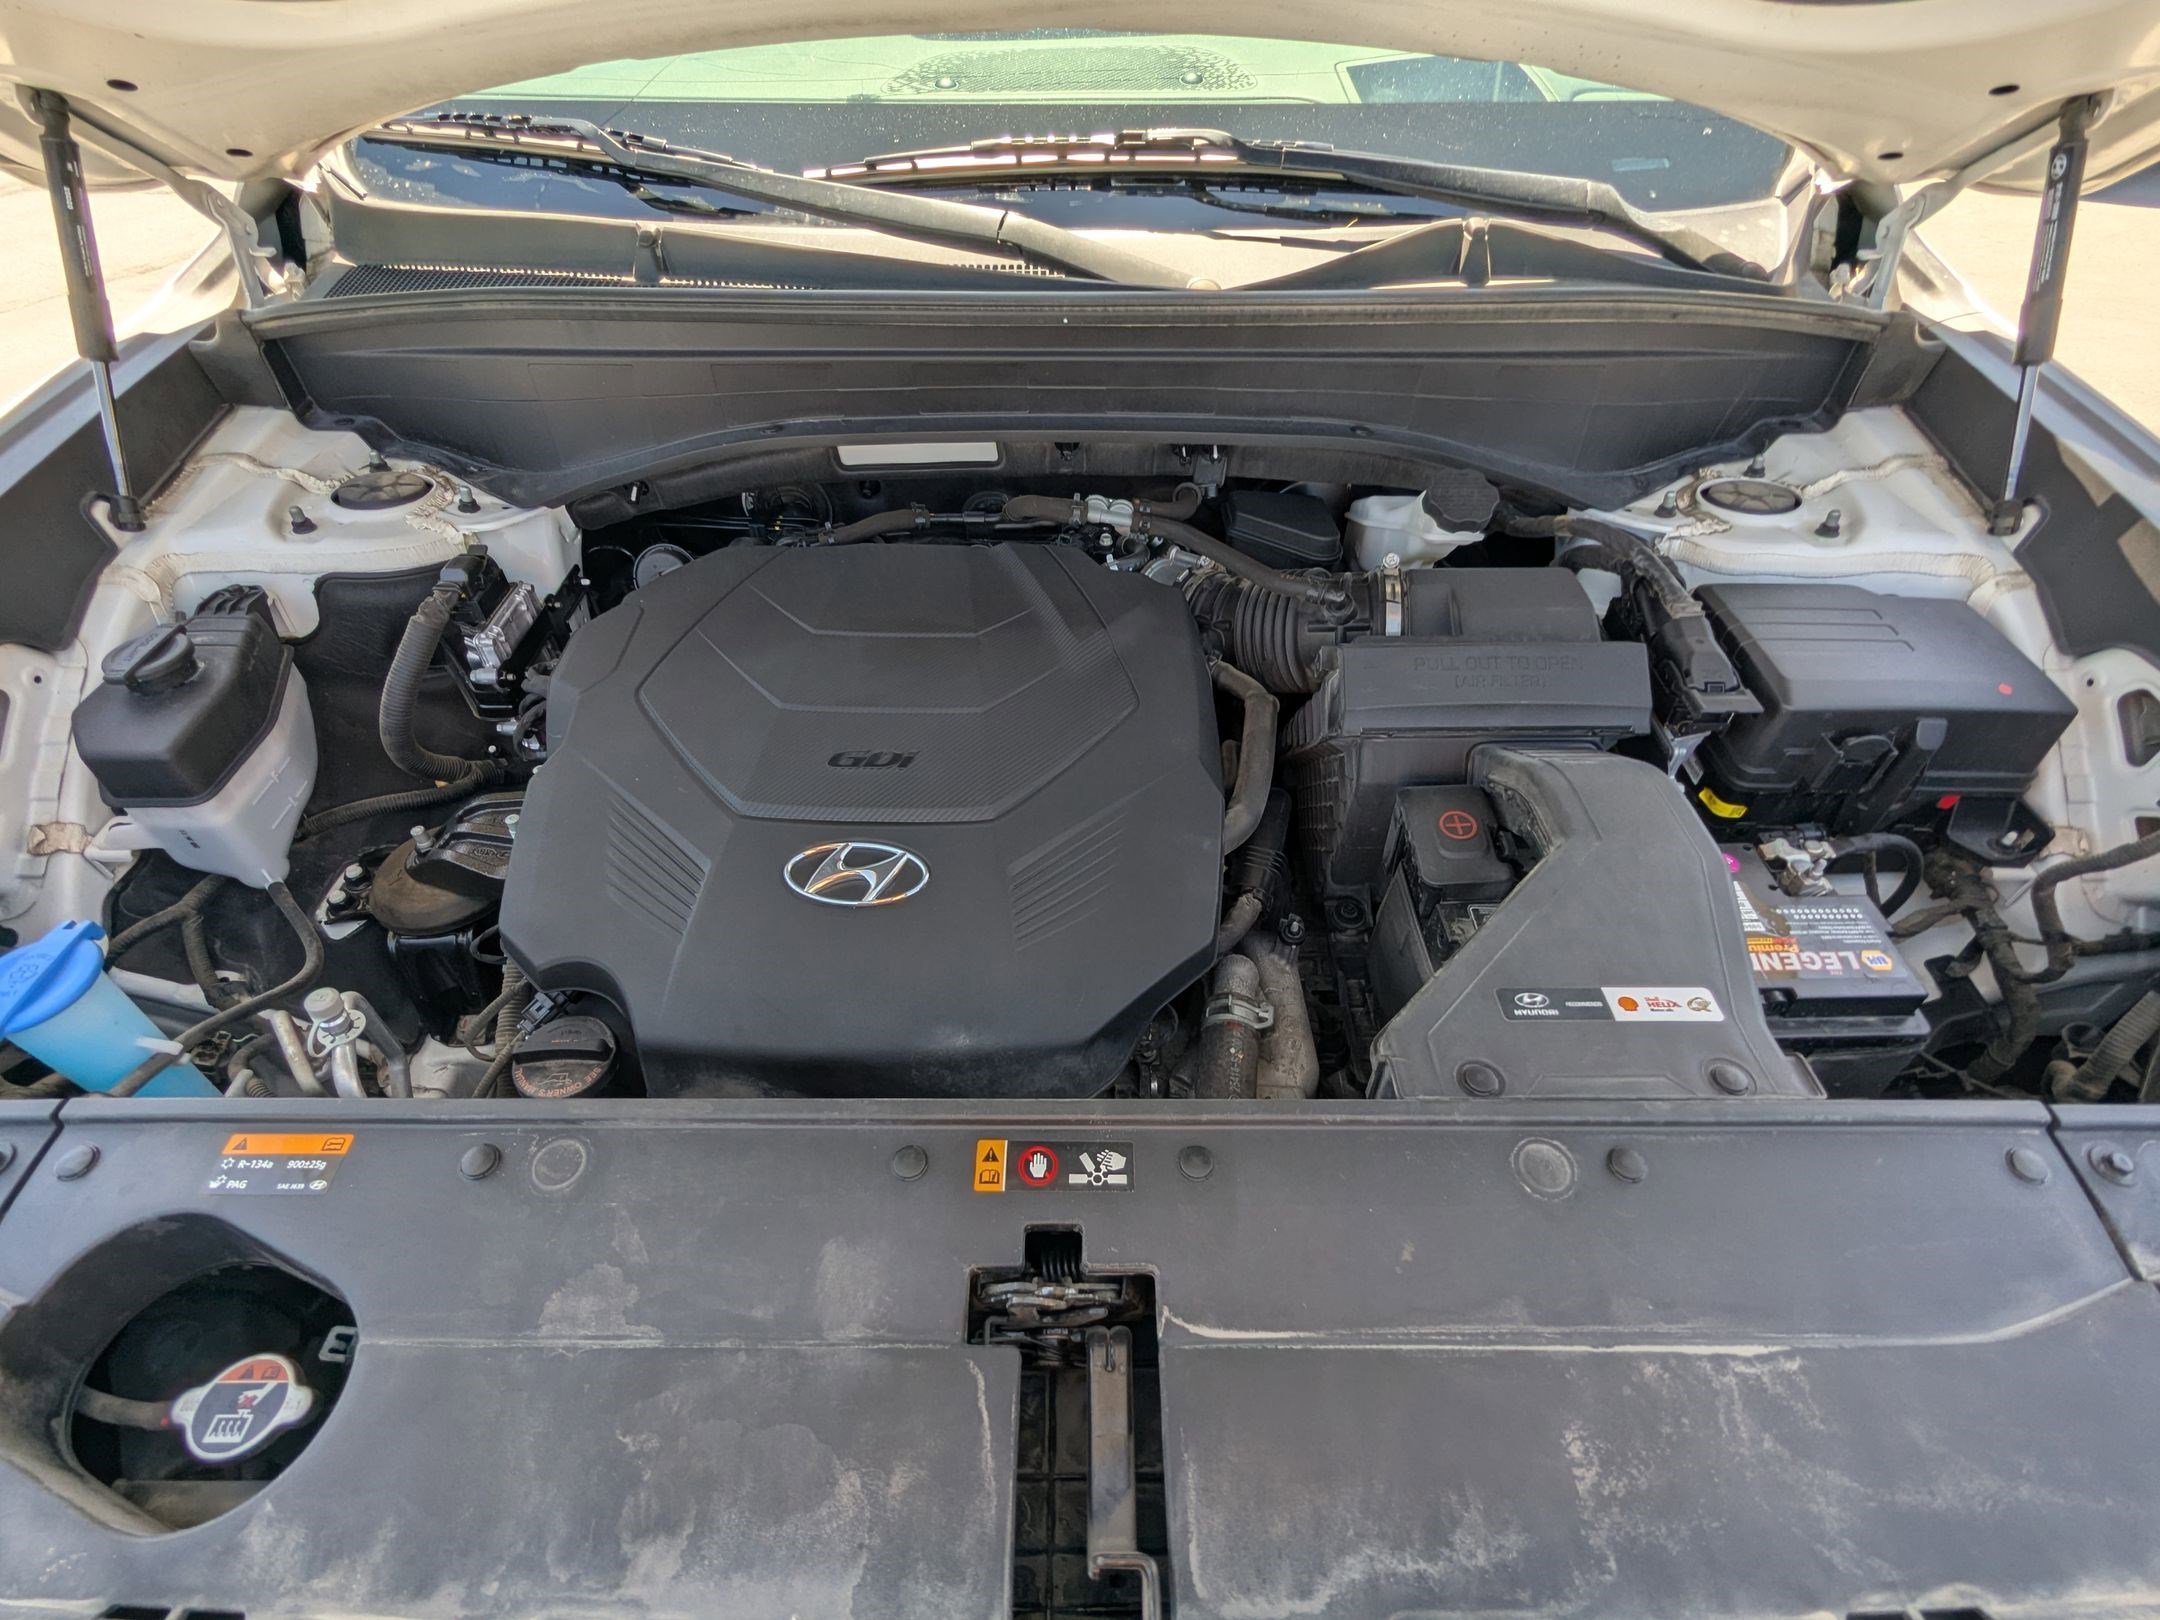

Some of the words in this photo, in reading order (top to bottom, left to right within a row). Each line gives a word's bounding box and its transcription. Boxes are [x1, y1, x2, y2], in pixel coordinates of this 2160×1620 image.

[1414, 656, 1460, 671] PULL
[1465, 656, 1501, 671] OUT
[1504, 656, 1529, 671] TO
[1535, 656, 1583, 671] OPEN
[1748, 944, 1800, 954] Premiu
[1750, 951, 1861, 971] LEGEN
[1647, 1000, 1682, 1008] HELIX
[1513, 1009, 1560, 1017] HYUNDAI
[583, 1066, 603, 1084] SEE
[237, 1159, 274, 1169] R-134a
[286, 1159, 327, 1170] 900±25g
[225, 1180, 249, 1189] PAG
